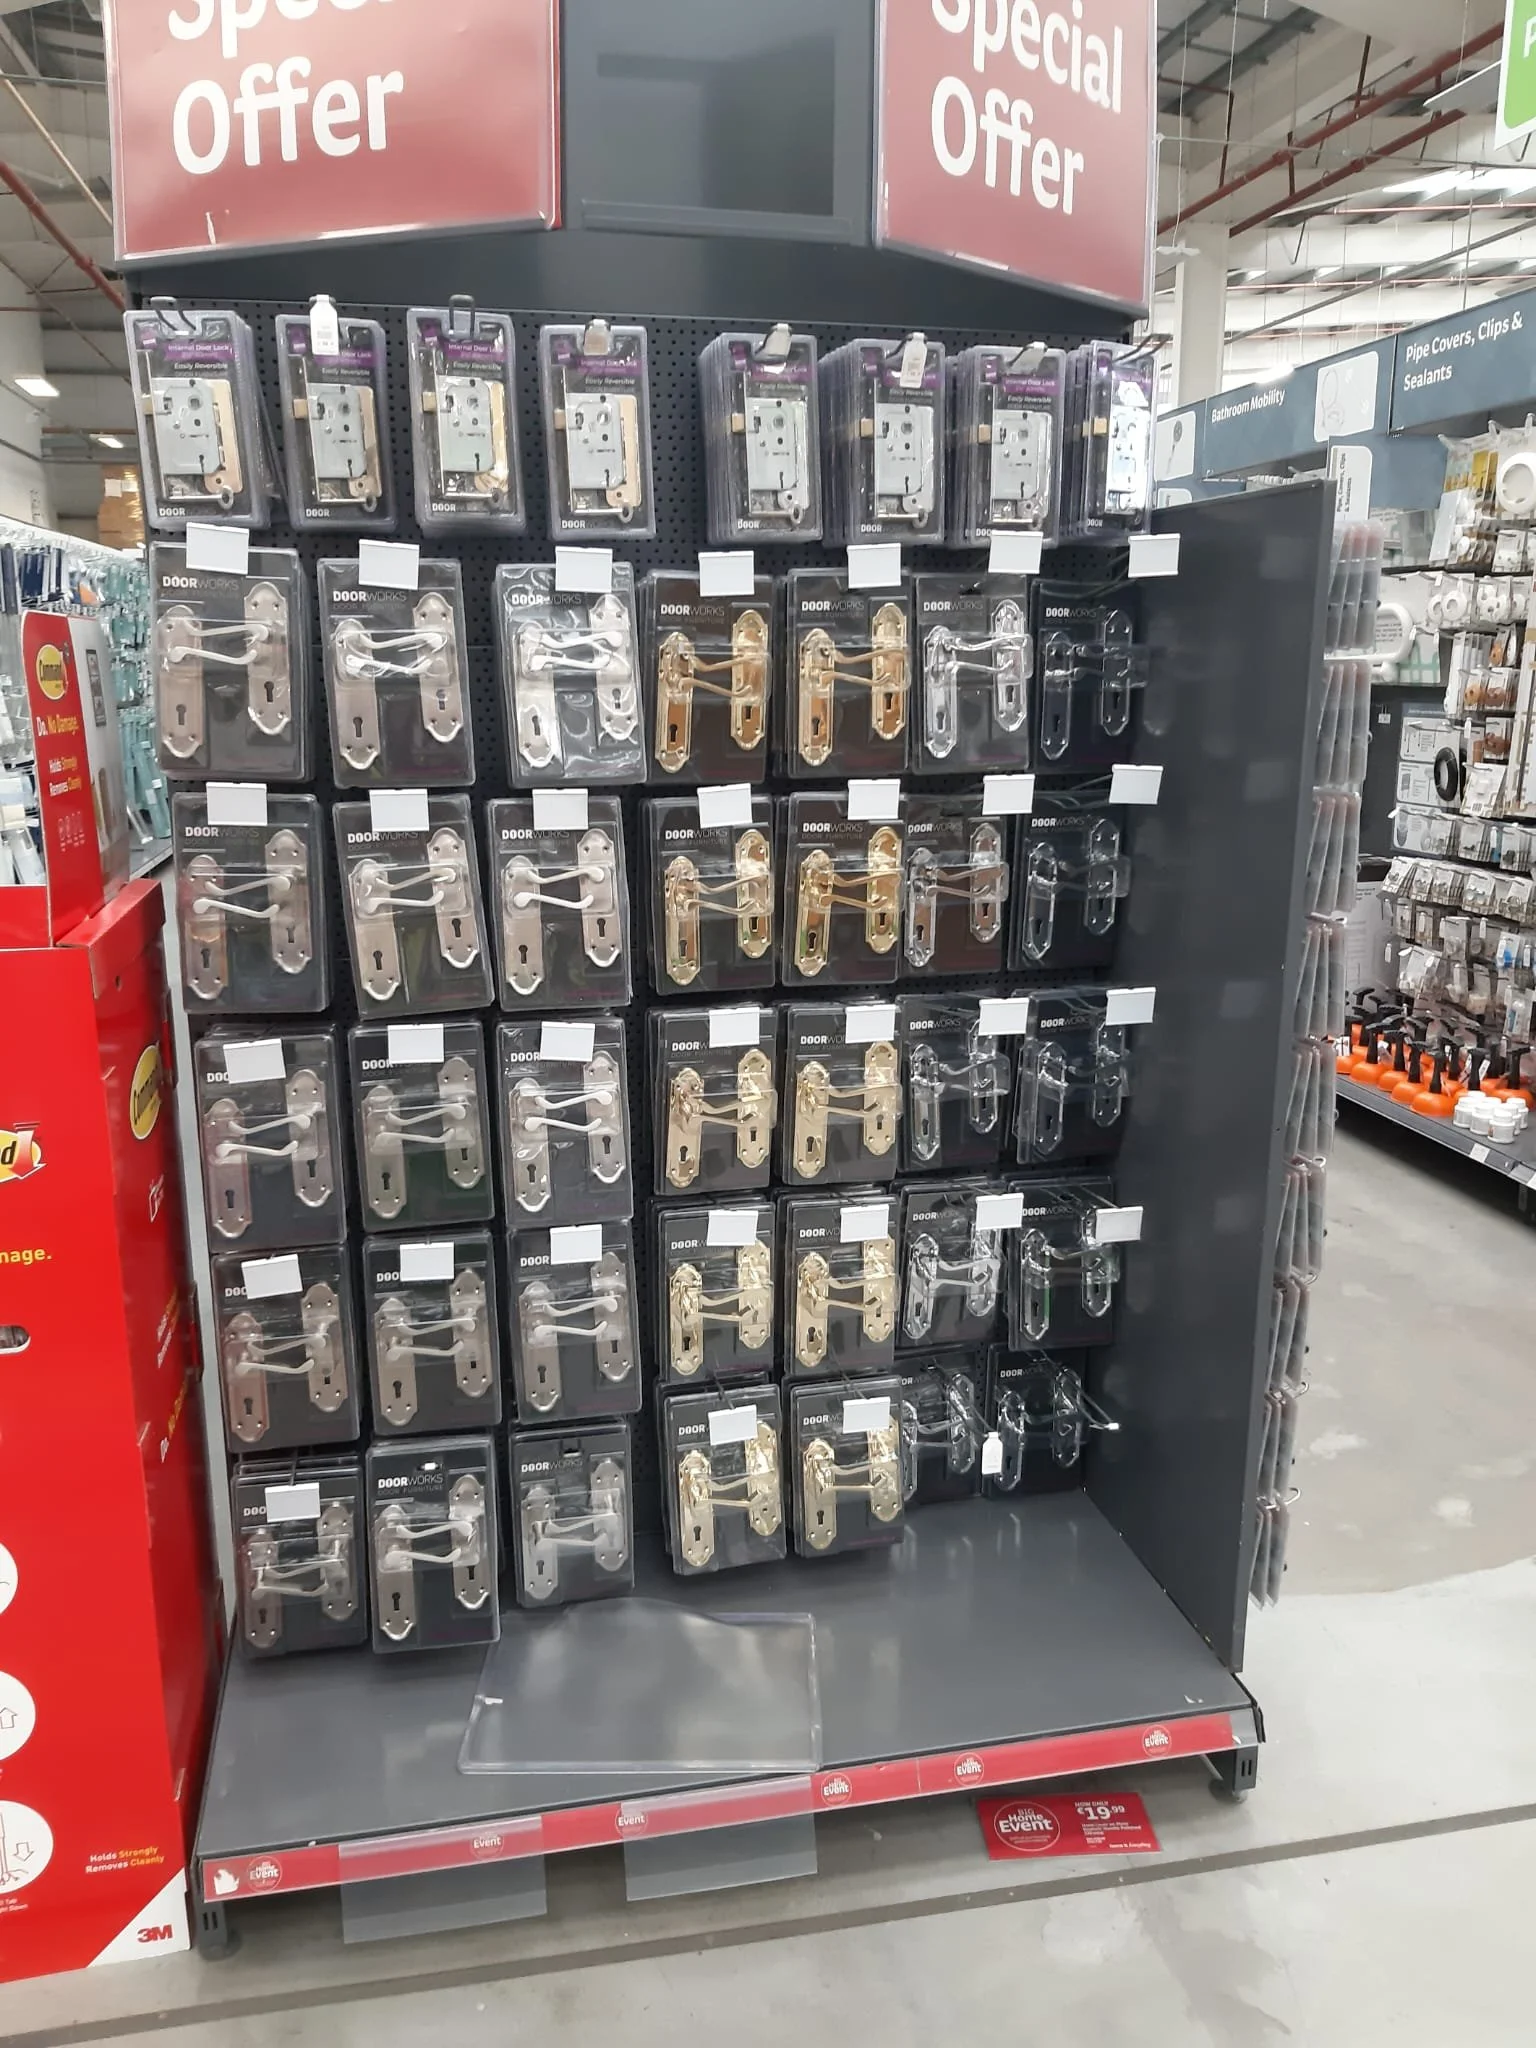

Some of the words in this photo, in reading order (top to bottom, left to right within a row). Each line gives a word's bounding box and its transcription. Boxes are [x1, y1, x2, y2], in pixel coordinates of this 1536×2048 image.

[173, 57, 404, 174] Offer
[931, 75, 1085, 216] Offer
[1406, 341, 1430, 364] Pipe
[1431, 329, 1476, 355] Covers,
[1478, 317, 1510, 341] Clips
[1511, 310, 1524, 331] &
[1403, 364, 1453, 392] Sealants
[1211, 400, 1250, 424] Bathroom
[1250, 388, 1286, 411] Mobility
[1144, 1736, 1169, 1747] Event
[957, 1765, 982, 1776] Event
[823, 1784, 849, 1796] Event
[618, 1815, 645, 1827] Event
[999, 1819, 1053, 1833] Event
[1008, 1813, 1043, 1823] Home
[473, 1836, 501, 1849] Event
[90, 1852, 118, 1863] Holds
[118, 1845, 158, 1859] Strongly
[85, 1861, 129, 1873] Removes
[130, 1855, 165, 1867] Cleanly
[137, 1924, 173, 1943] 3M
